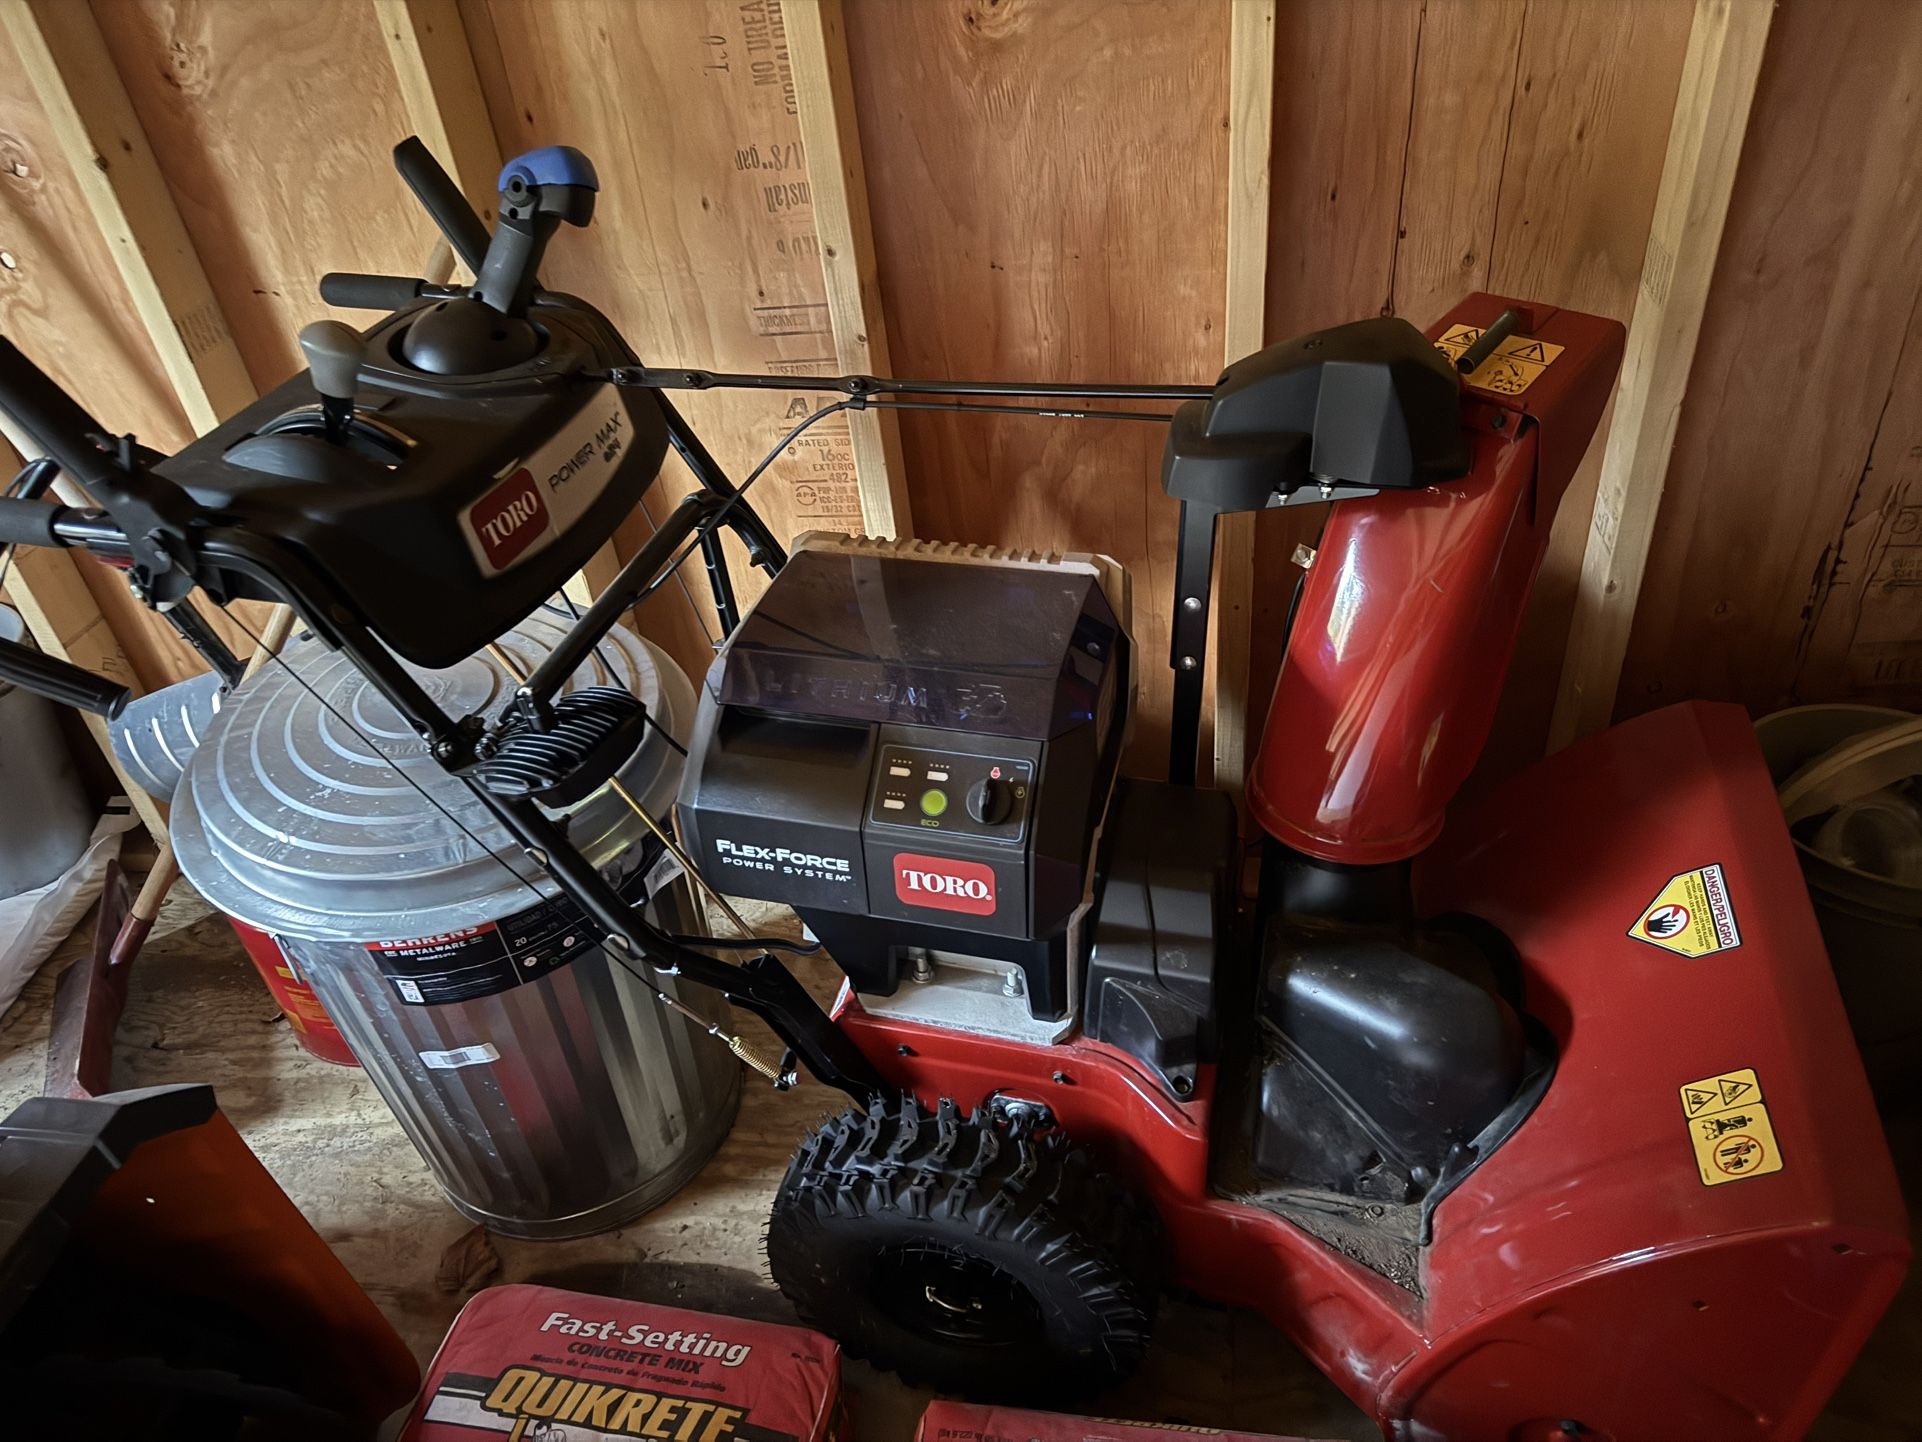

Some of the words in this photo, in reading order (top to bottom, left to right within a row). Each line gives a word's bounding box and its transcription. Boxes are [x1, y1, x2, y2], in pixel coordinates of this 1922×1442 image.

[750, 61, 778, 86] NO
[547, 442, 597, 493] POWER
[594, 411, 623, 449] MAX
[797, 439, 830, 447] RATED
[828, 472, 849, 483] 482
[481, 490, 538, 547] TORO
[920, 819, 940, 827] ECO
[715, 839, 850, 872] FLEX-FORCE
[722, 856, 775, 872] POWER
[1704, 868, 1734, 946] DANGER/PELIGRO
[399, 940, 467, 957] METALWARE
[514, 936, 527, 947] 20
[540, 1311, 753, 1367] Fast-Setting
[567, 1341, 663, 1367] CONCRETE
[664, 1356, 705, 1374] MIX
[485, 1369, 744, 1442] QUIKRETE
